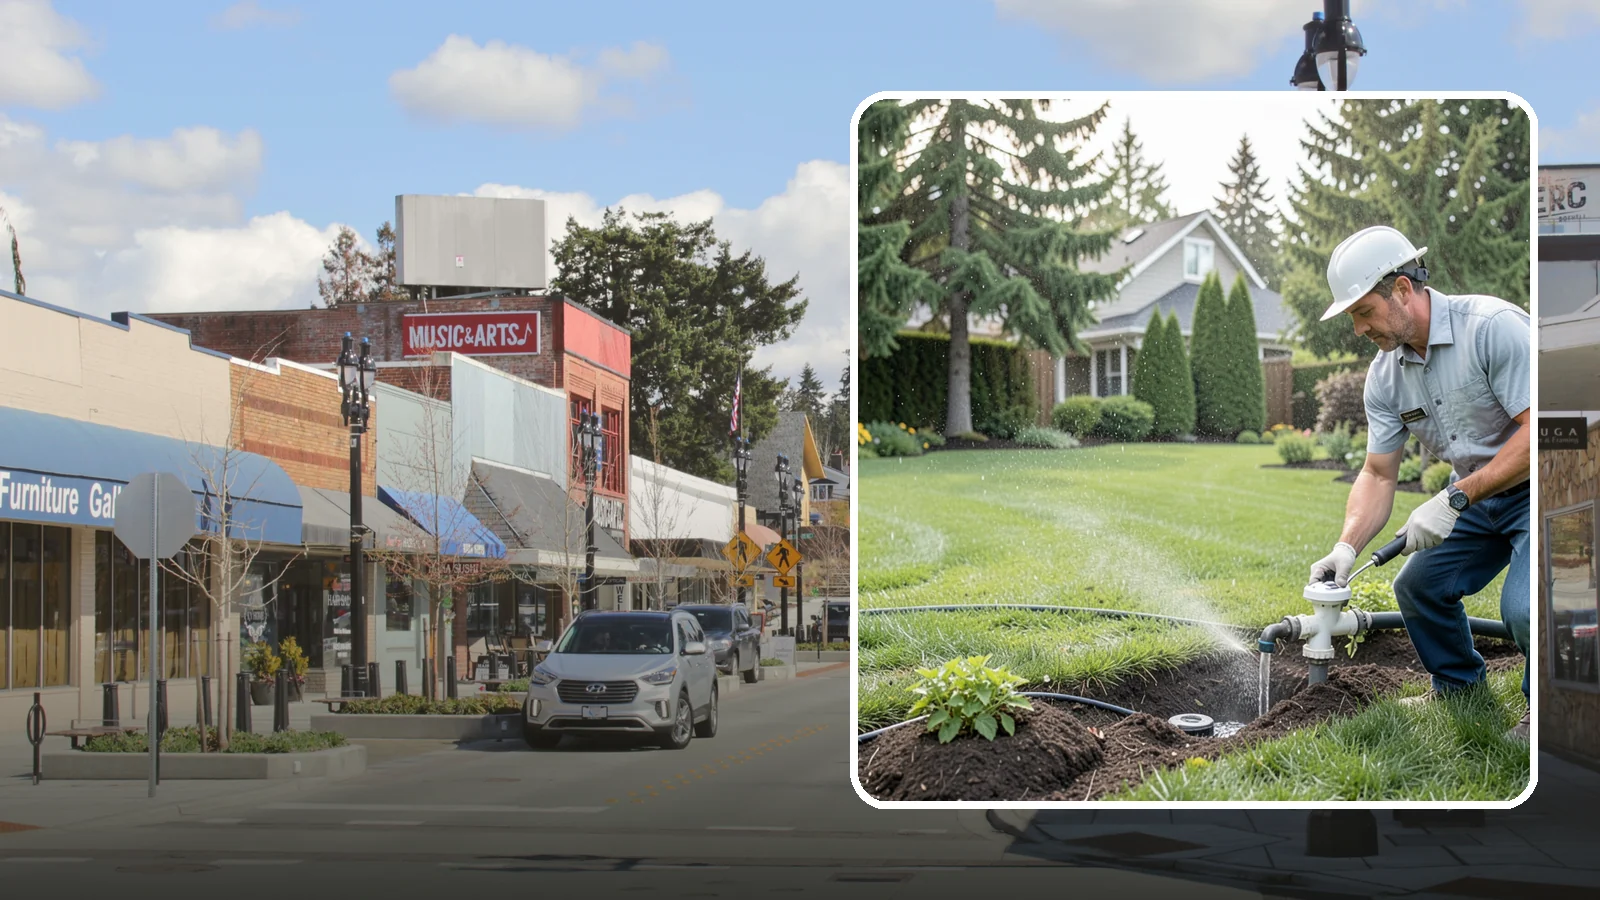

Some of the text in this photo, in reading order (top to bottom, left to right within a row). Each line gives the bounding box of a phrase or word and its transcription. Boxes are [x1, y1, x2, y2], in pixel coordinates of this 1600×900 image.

[1540, 427, 1578, 437] UGA
[1551, 436, 1579, 444] Framing
[0, 471, 122, 519] Furniture Gal
